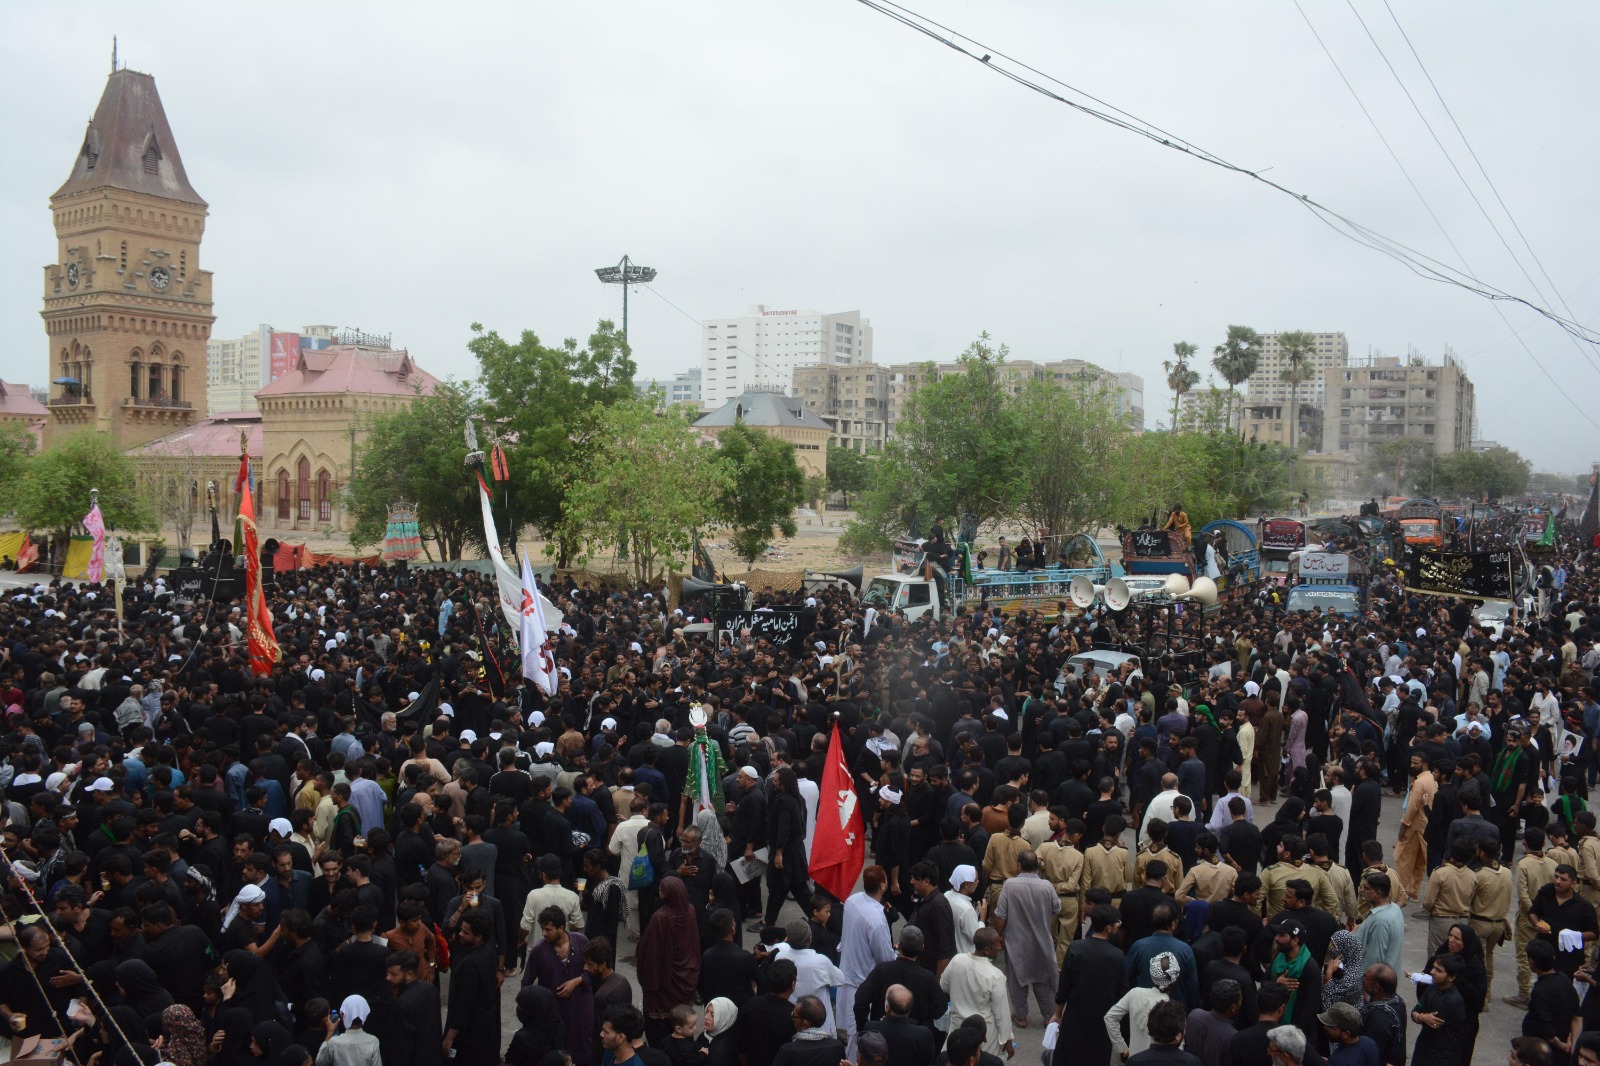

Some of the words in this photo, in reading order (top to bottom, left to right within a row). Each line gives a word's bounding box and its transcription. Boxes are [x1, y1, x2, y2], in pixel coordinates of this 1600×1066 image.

[1326, 559, 1344, 572] سبیل
[180, 579, 202, 591] انجمن
[726, 614, 746, 631] ہزارہ
[744, 612, 764, 631] مغل
[781, 612, 798, 632] انجمن
